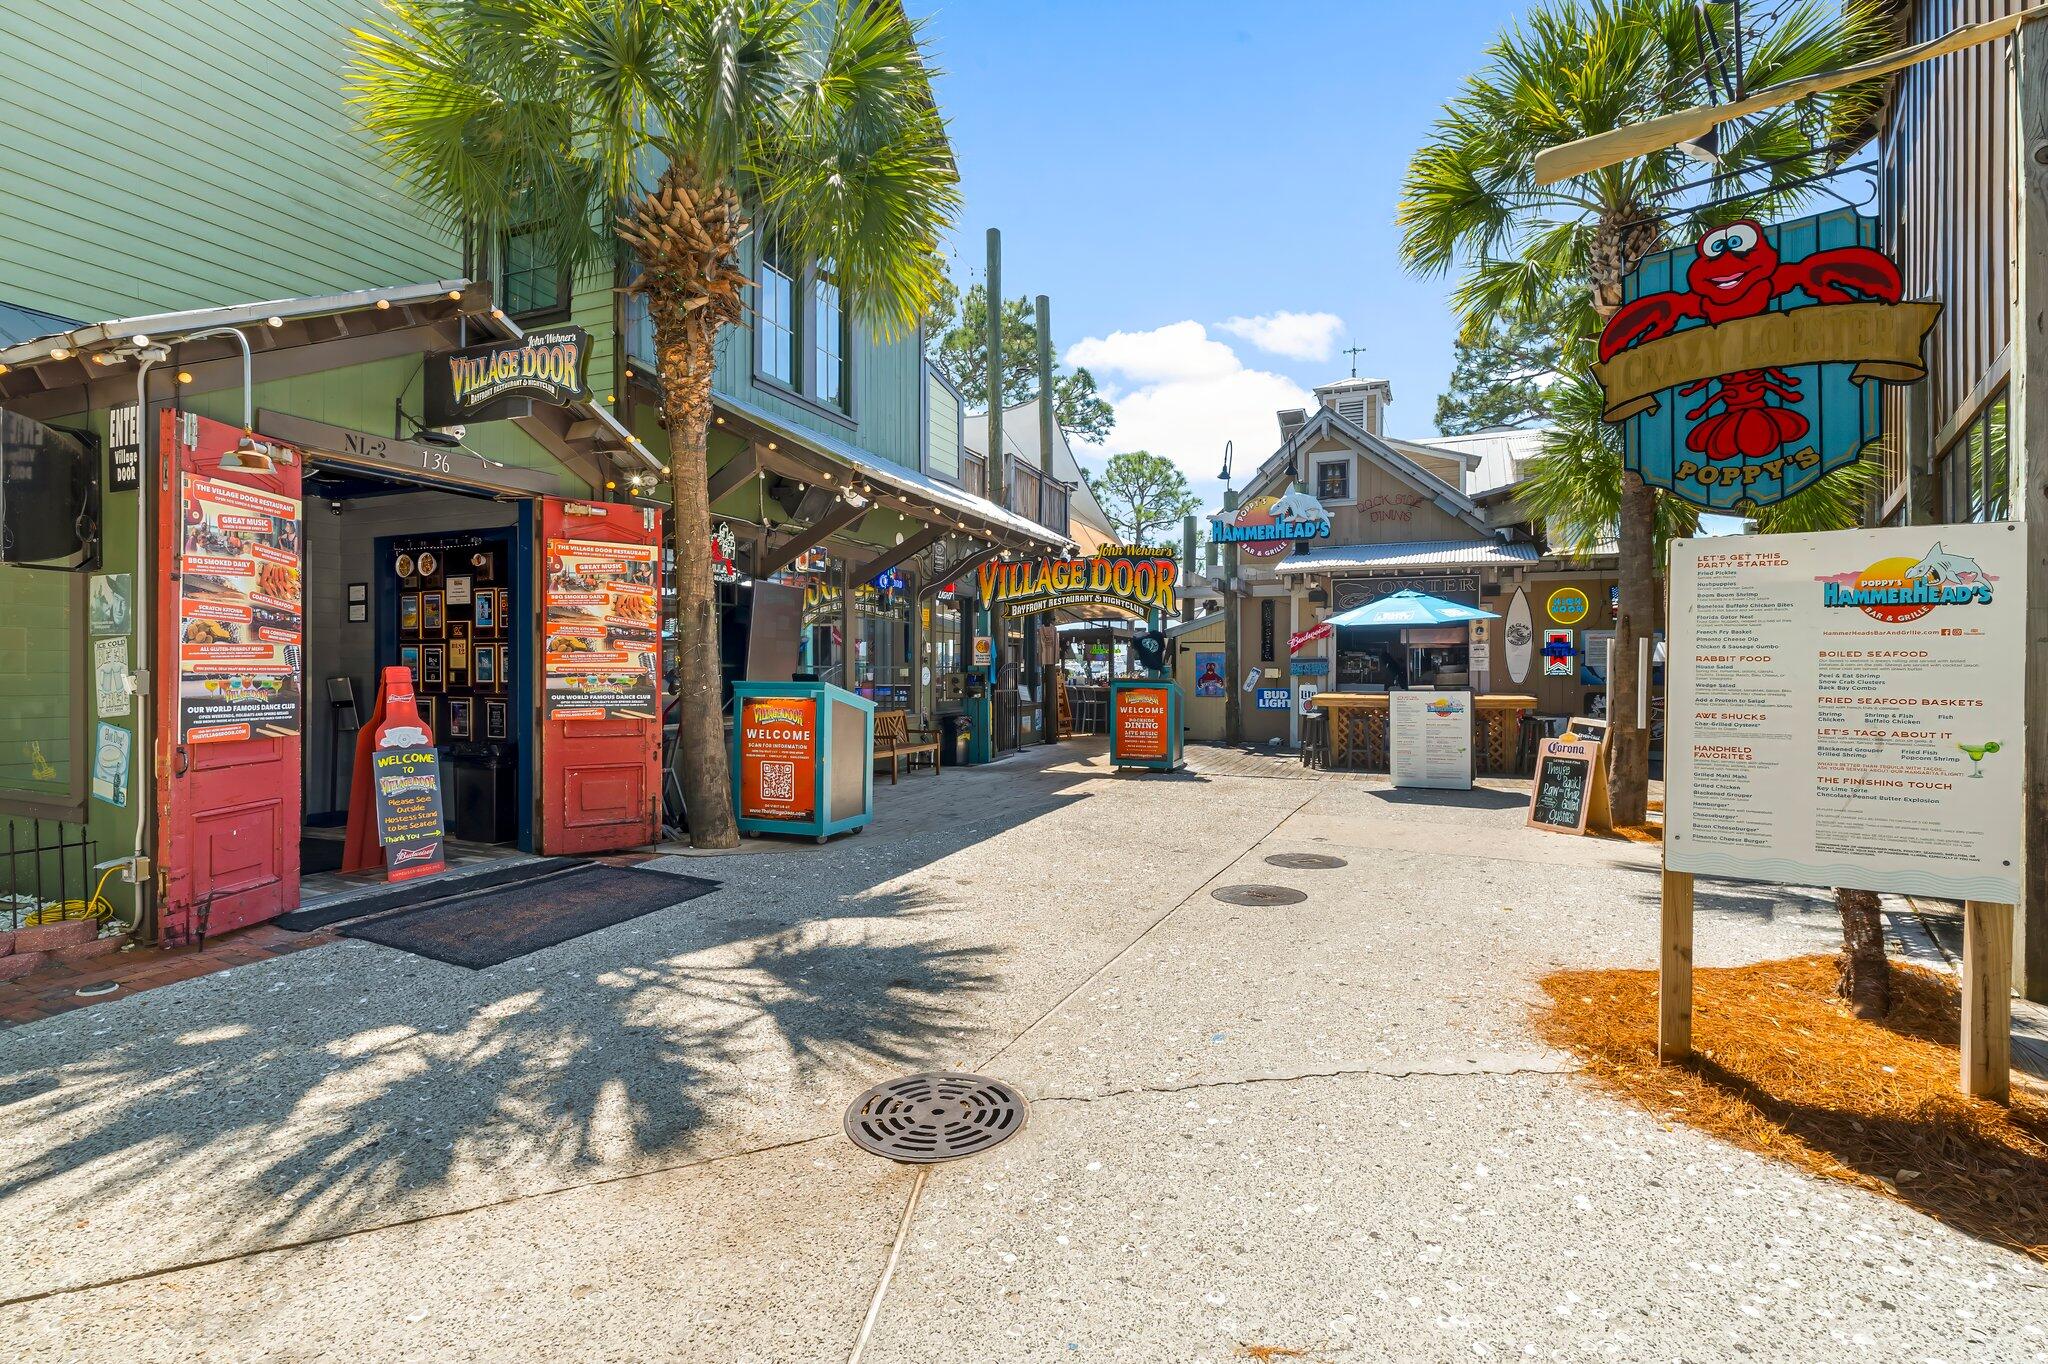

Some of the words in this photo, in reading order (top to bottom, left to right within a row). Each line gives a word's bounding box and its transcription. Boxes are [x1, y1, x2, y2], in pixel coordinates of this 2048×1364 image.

[528, 335, 545, 348] John
[1623, 331, 1729, 390] CRAZY
[1739, 308, 1896, 357] LOBSTER
[450, 350, 520, 404] VILLAGE
[520, 343, 581, 393] DOOR
[471, 388, 494, 404] BAYFRONT
[493, 380, 522, 395] RESTAURANT
[528, 380, 556, 393] NIGHTCLUB
[115, 450, 138, 467] Village
[345, 432, 386, 458] NL-2
[422, 450, 450, 473] 136
[117, 466, 136, 482] DOOR
[1676, 446, 1821, 488] POPPY'S
[196, 484, 211, 492] THE
[212, 486, 240, 498] VILLAGE
[240, 493, 259, 503] DOOR
[259, 497, 294, 512] RESTAURANT
[1237, 497, 1268, 522] POPPY'S
[222, 516, 246, 524] GREAT
[247, 518, 268, 527] MUSIC
[1212, 513, 1331, 544] HAMMERHEAD'S
[1095, 543, 1126, 559] John
[1240, 542, 1256, 556] BAR
[1264, 540, 1289, 557] GRILLE
[204, 558, 232, 567] SMOKED
[977, 556, 1088, 612] VILLAGE
[1090, 557, 1181, 617] DOOR
[1377, 578, 1477, 594] OYSTER
[1824, 578, 1993, 608] HAMMERHEAD'S
[1011, 599, 1047, 616] BAYFRONT
[1048, 594, 1094, 609] RESTAURANT
[1094, 594, 1102, 603] &
[1102, 596, 1144, 616] NIGHTCLUB
[1864, 607, 1883, 619] BAR
[1897, 606, 1931, 622] GRILLE
[1287, 624, 1332, 648] Budweiser
[1264, 691, 1289, 699] BUD
[1857, 697, 1917, 706] SEAFOOD
[1921, 699, 1984, 707] BASKETS
[187, 706, 204, 714] OUR
[205, 705, 231, 713] WORLD
[232, 704, 260, 712] FAMOUS
[260, 703, 280, 711] DANCE
[281, 702, 295, 710] CLUB
[1259, 699, 1291, 708] LIGHT
[746, 729, 810, 741] WELCOME
[1853, 729, 1887, 737] TACO
[1891, 731, 1937, 739] ABOUT
[1548, 742, 1585, 755] Corona
[1694, 745, 1752, 754] HANDHELD
[377, 753, 435, 768] WELCOME
[1694, 752, 1753, 761] FAVORITES
[403, 766, 414, 774] TO
[1817, 776, 1839, 784] THE
[1843, 778, 1904, 788] FINISHING
[1907, 781, 1953, 790] TOUCH
[388, 797, 415, 806] Please
[416, 794, 432, 803] See
[1903, 796, 1940, 804] Explosion
[396, 805, 426, 814] Outside
[384, 814, 417, 824] Hostess
[417, 811, 438, 820] Stand
[387, 823, 396, 832] to
[397, 822, 409, 831] be
[409, 819, 438, 830] Seated
[384, 835, 406, 844] Thank
[405, 832, 420, 841] You
[397, 846, 437, 862] Budweiser
